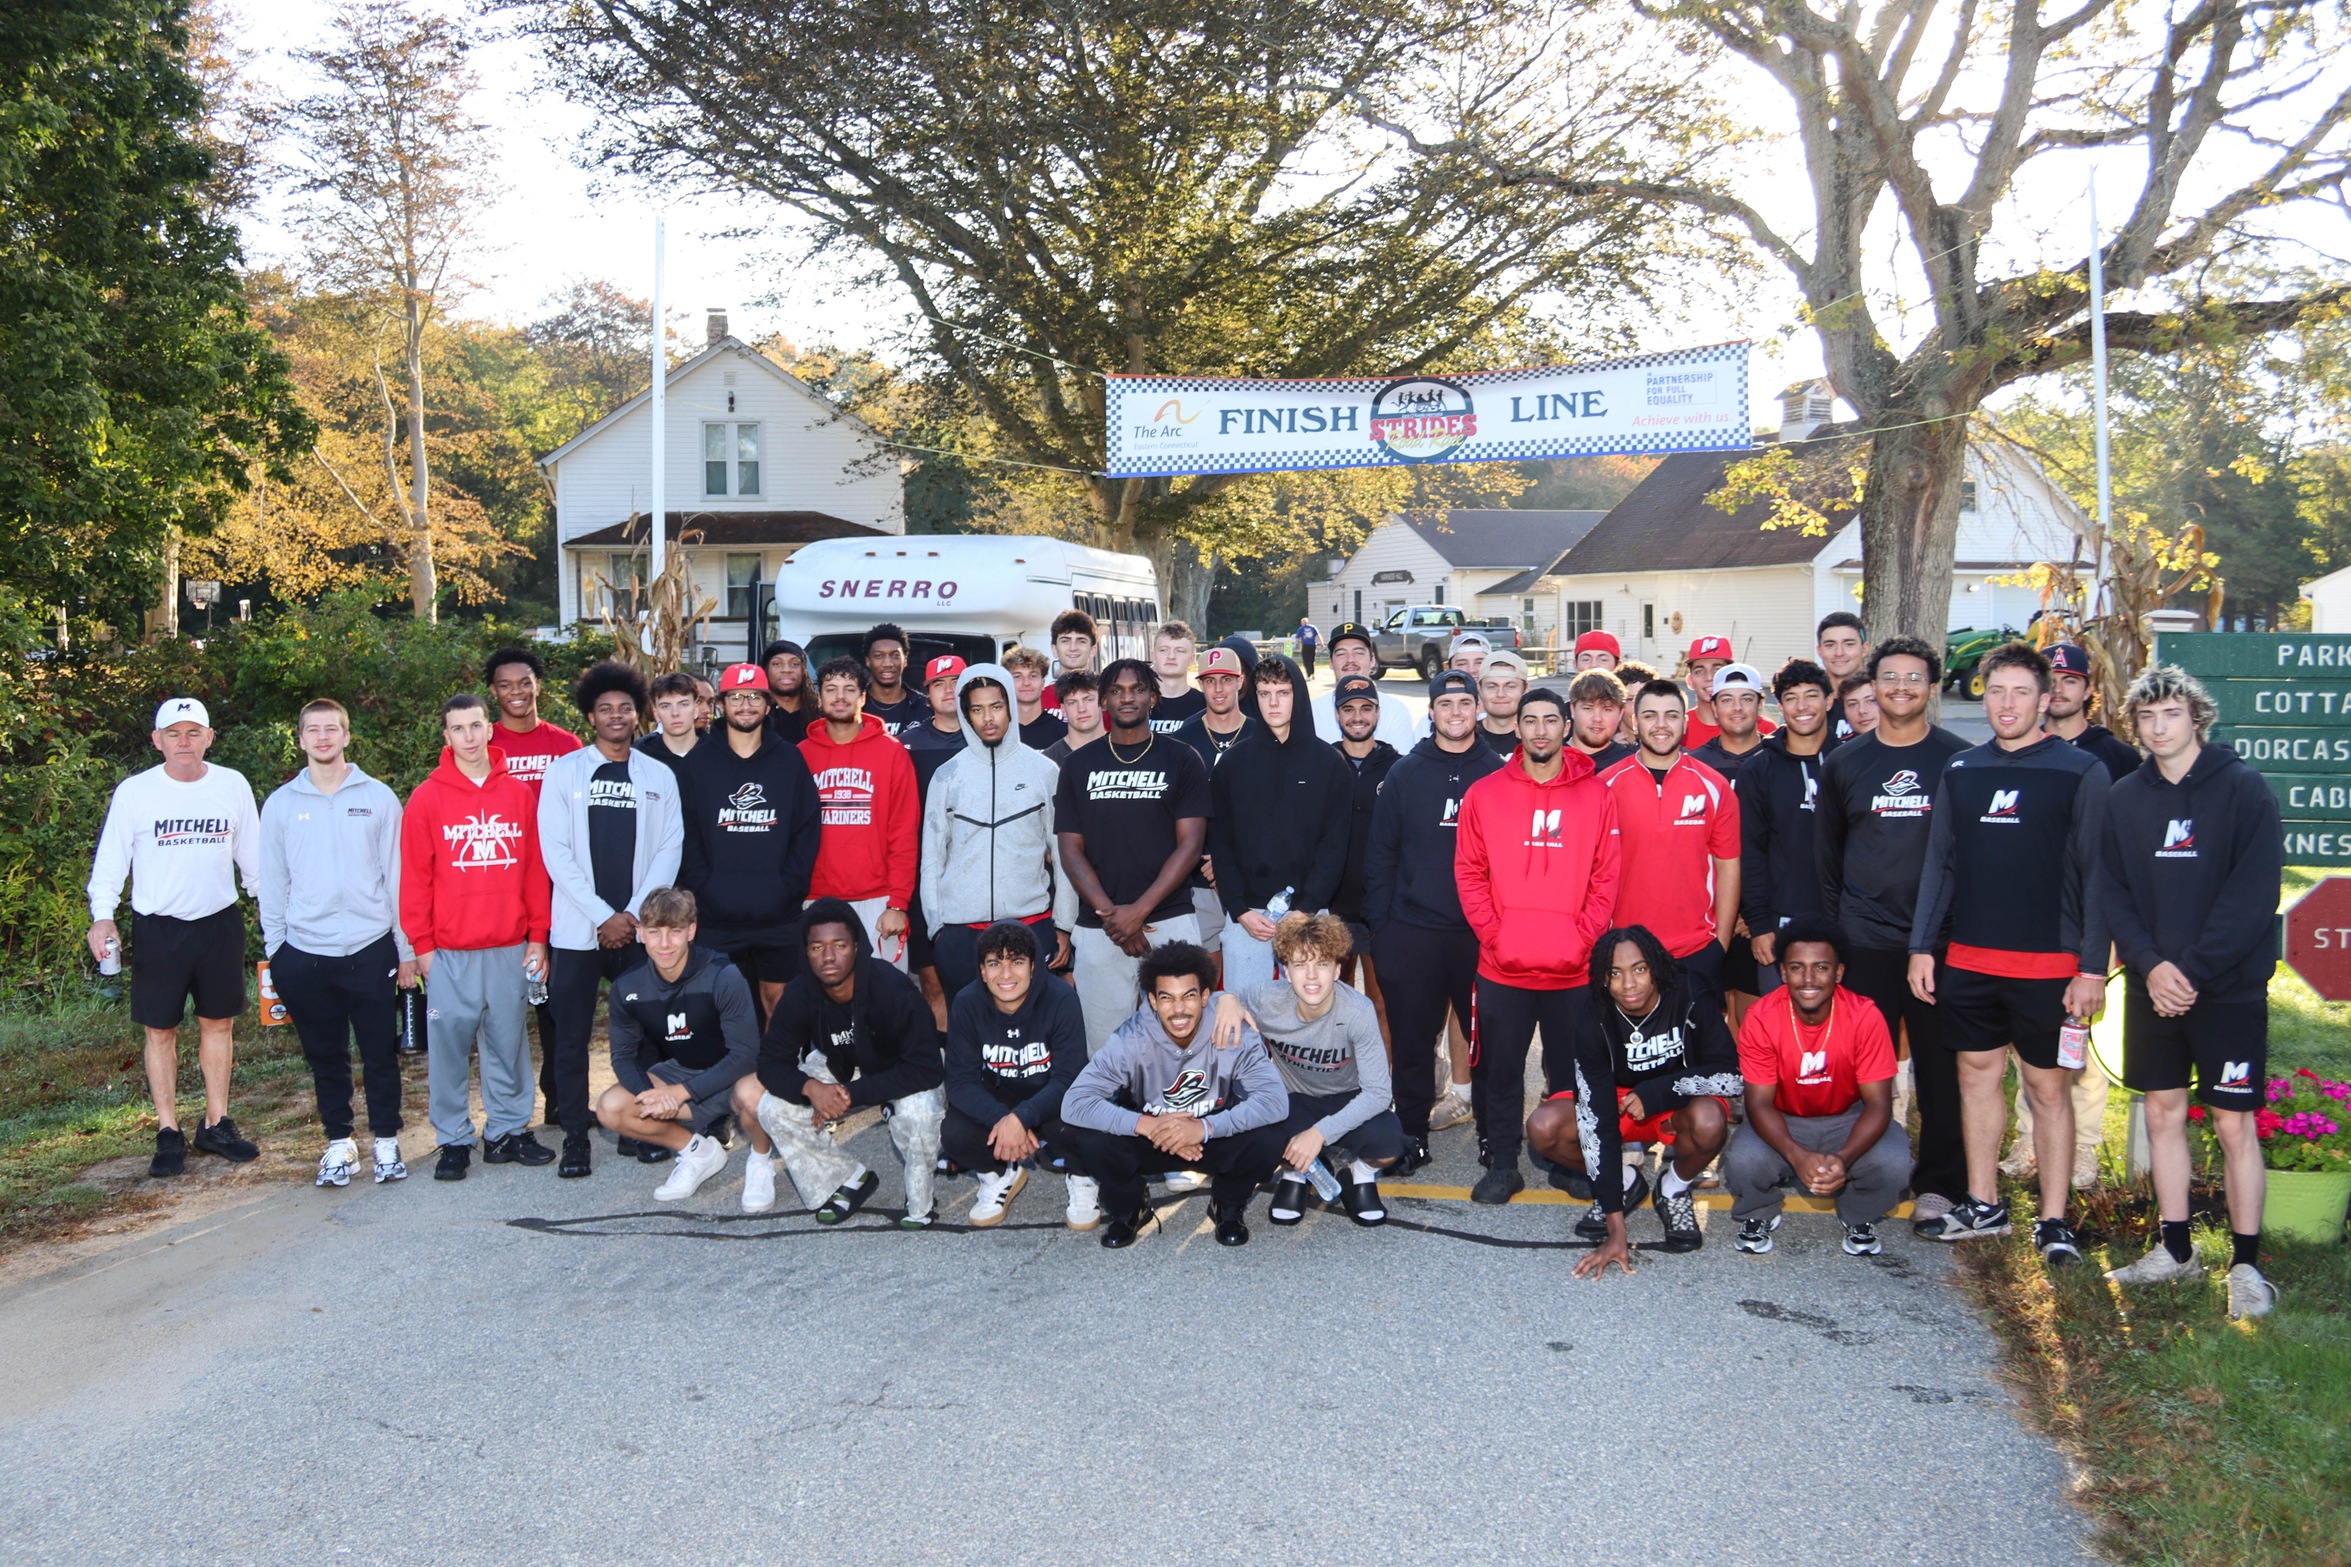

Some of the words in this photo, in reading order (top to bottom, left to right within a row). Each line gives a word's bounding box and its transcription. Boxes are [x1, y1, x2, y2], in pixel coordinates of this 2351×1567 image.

[1646, 373, 1714, 386] PARTNERSHIP
[1646, 387, 1663, 395] FOR
[1666, 386, 1686, 394] FULL
[1647, 394, 1694, 406] EQUALITY
[1218, 406, 1359, 434] FINISH
[1510, 390, 1608, 422] LINE
[1632, 415, 1680, 427] Achieve
[1684, 411, 1712, 424] with
[1133, 426, 1157, 439] The
[1160, 426, 1182, 437] Arc
[1369, 414, 1477, 441] STRIDES
[1133, 442, 1158, 451] Eastern
[1159, 441, 1199, 450] Connecticut
[1385, 429, 1426, 450] Road
[1429, 428, 1465, 449] Race
[818, 580, 958, 600] SNERRO
[1343, 623, 1354, 635] P
[2278, 645, 2351, 667] PARK
[2235, 739, 2350, 761] DORCAS
[1086, 771, 1168, 791] MITCHELL
[1089, 790, 1161, 800] BASKETBALL
[1871, 795, 1930, 811] MITCHELL
[1988, 790, 2020, 815] M
[717, 808, 777, 824] MITCHELL
[1680, 794, 1706, 818] M
[1880, 810, 1923, 818] BASEBALL
[821, 809, 872, 825] ARINERS
[1531, 809, 1562, 838] M
[1979, 816, 2021, 824] BASEBALL
[155, 819, 229, 839] MITCHELL
[442, 822, 523, 841] MITCHELL
[727, 825, 770, 833] BASEBALL
[2163, 819, 2193, 848] M
[157, 836, 226, 847] BASKETBALL
[472, 840, 498, 861] M
[2155, 850, 2198, 858] BASEBALL
[667, 1012, 687, 1034] M
[1270, 1038, 1346, 1065] MITCHELL
[1624, 1026, 1682, 1060] TCHELL
[982, 1042, 1051, 1066] MITCHELL
[1800, 1050, 1827, 1077] M
[2220, 1061, 2250, 1084] M
